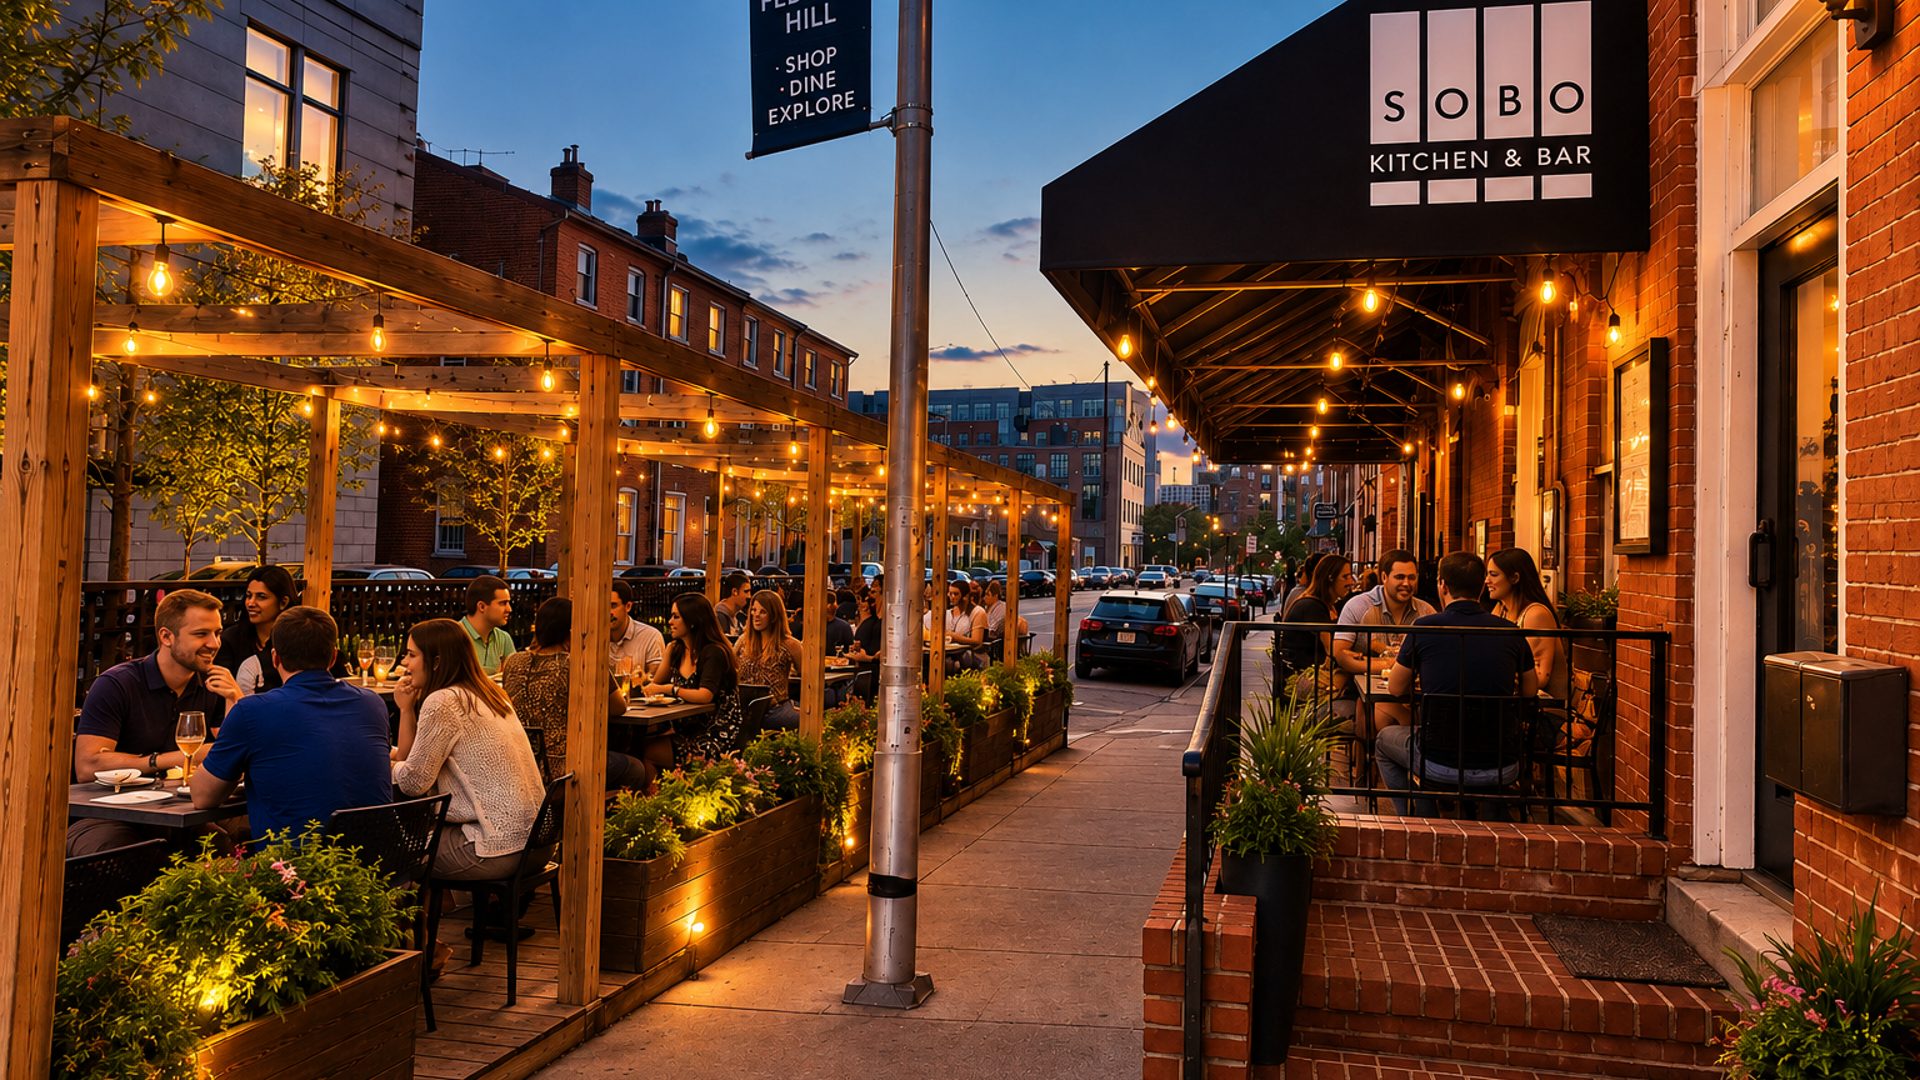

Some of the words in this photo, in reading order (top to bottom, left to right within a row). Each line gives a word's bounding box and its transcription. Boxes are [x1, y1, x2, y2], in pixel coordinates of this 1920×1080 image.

[785, 2, 837, 34] HILL
[785, 46, 837, 74] SHOP
[789, 70, 836, 97] DINE
[768, 90, 856, 126] EXPLORE
[1383, 81, 1585, 123] SOBO
[1370, 150, 1489, 174] KITCHEN
[1504, 148, 1523, 168] &
[1537, 145, 1592, 167] BAR
